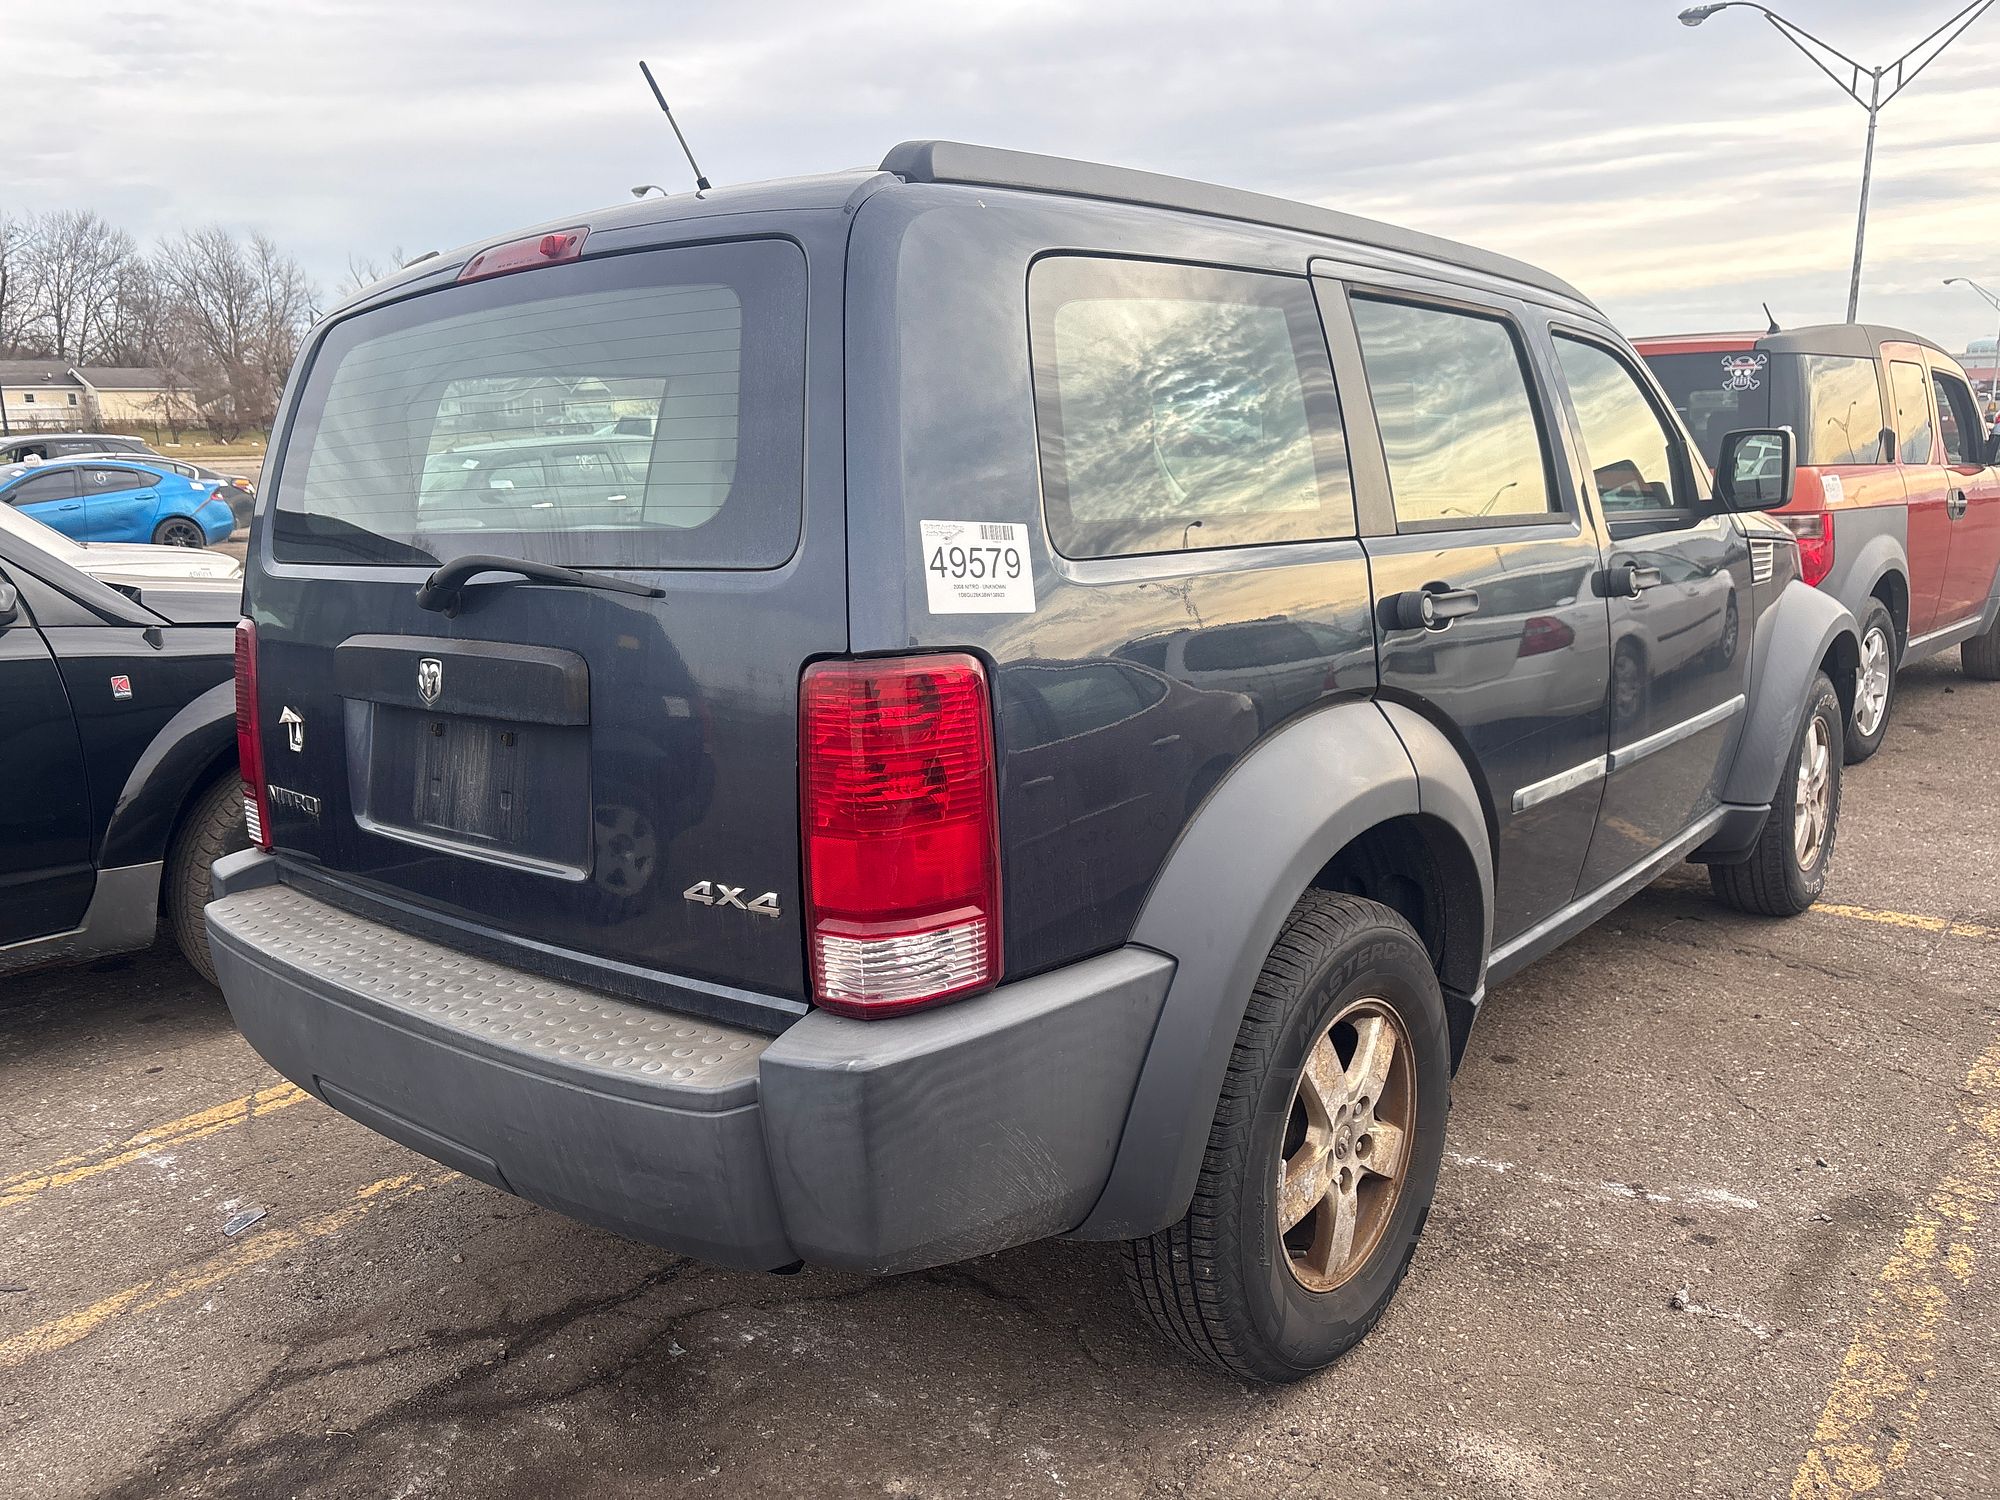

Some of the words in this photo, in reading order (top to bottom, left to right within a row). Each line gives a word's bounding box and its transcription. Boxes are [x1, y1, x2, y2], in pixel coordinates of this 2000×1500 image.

[930, 546, 1021, 579] 49579
[268, 784, 321, 816] NITRO
[1299, 942, 1440, 1049] MASTERCRA
